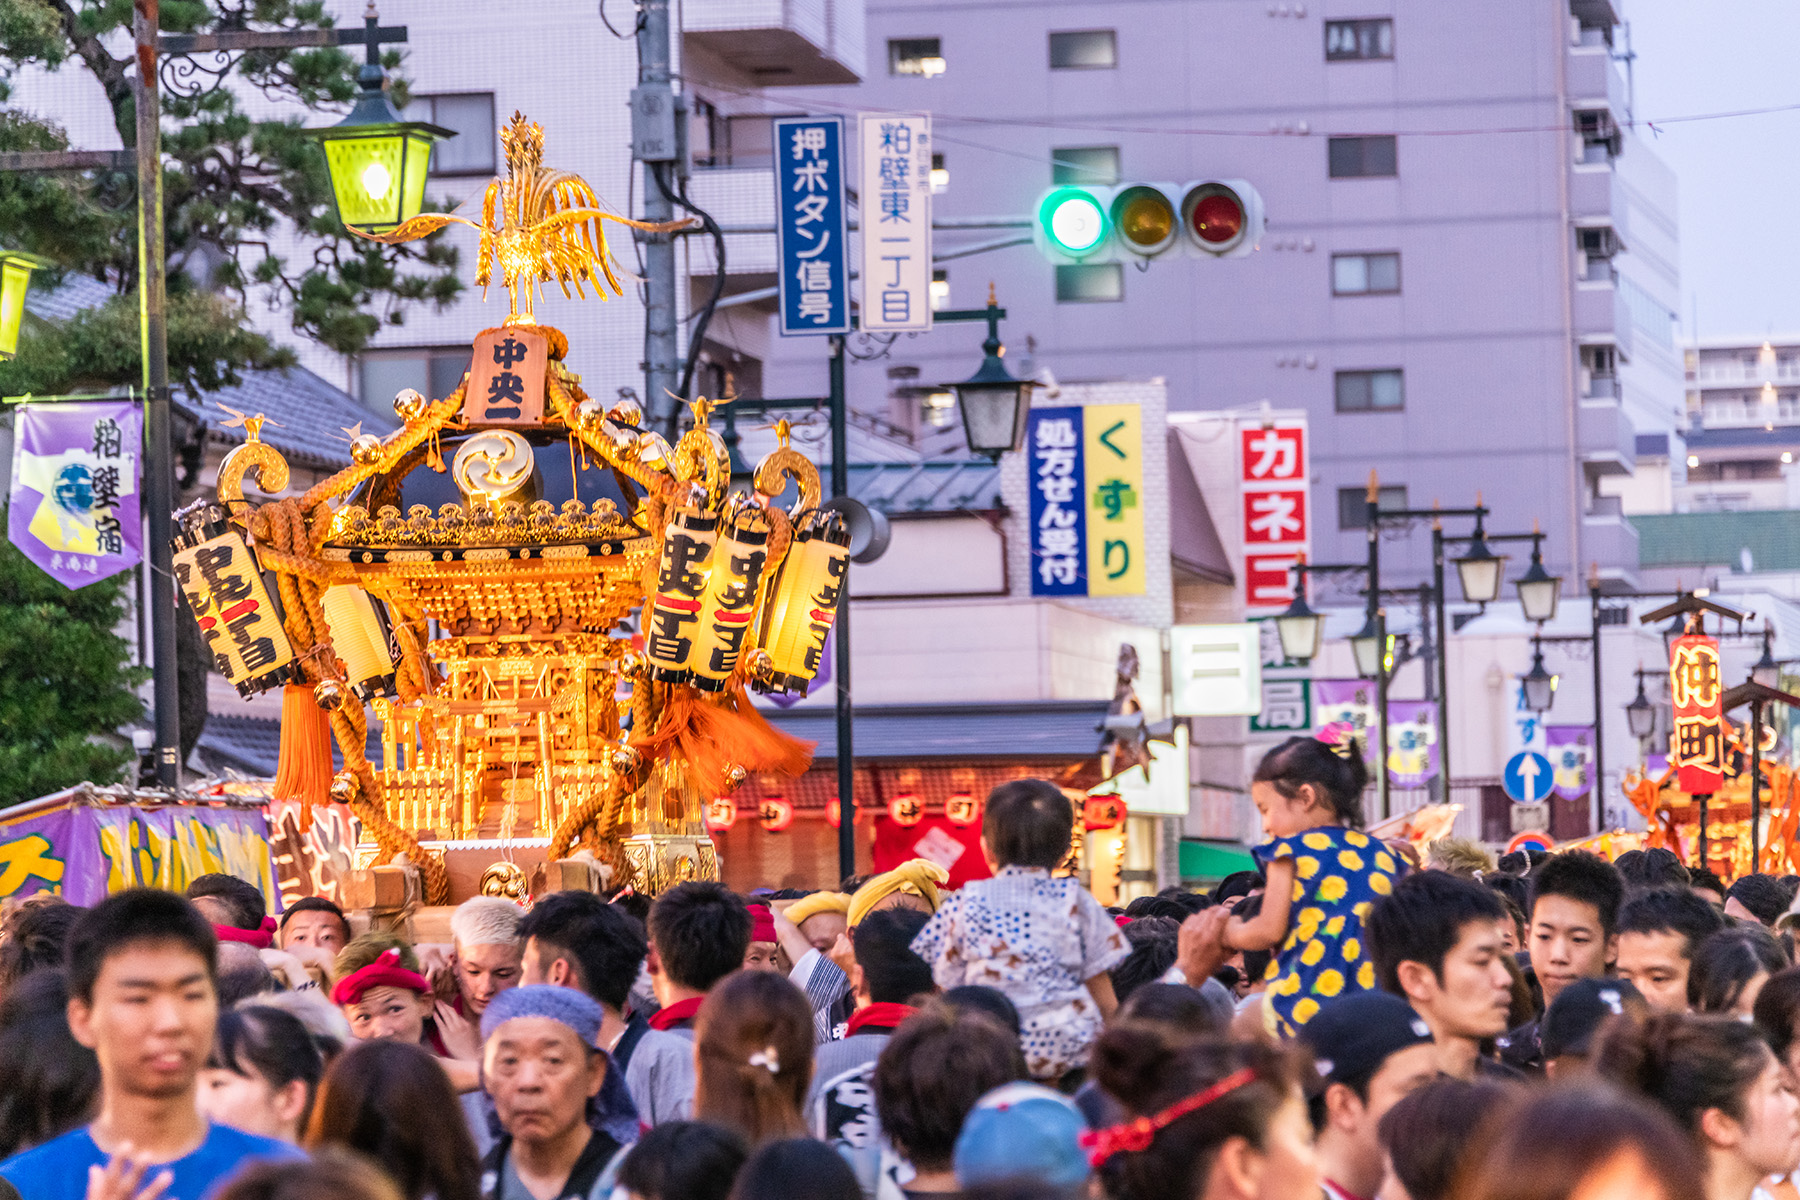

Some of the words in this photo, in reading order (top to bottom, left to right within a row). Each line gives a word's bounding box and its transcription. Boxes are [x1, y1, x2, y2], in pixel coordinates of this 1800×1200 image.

[791, 127, 832, 324] 押ボタン信号
[880, 122, 911, 322] 粕壁東一丁目
[485, 338, 528, 419] 中央一
[1035, 418, 1080, 586] 処方せん受付
[1097, 420, 1132, 580] くすり
[1250, 431, 1300, 599] カネコ
